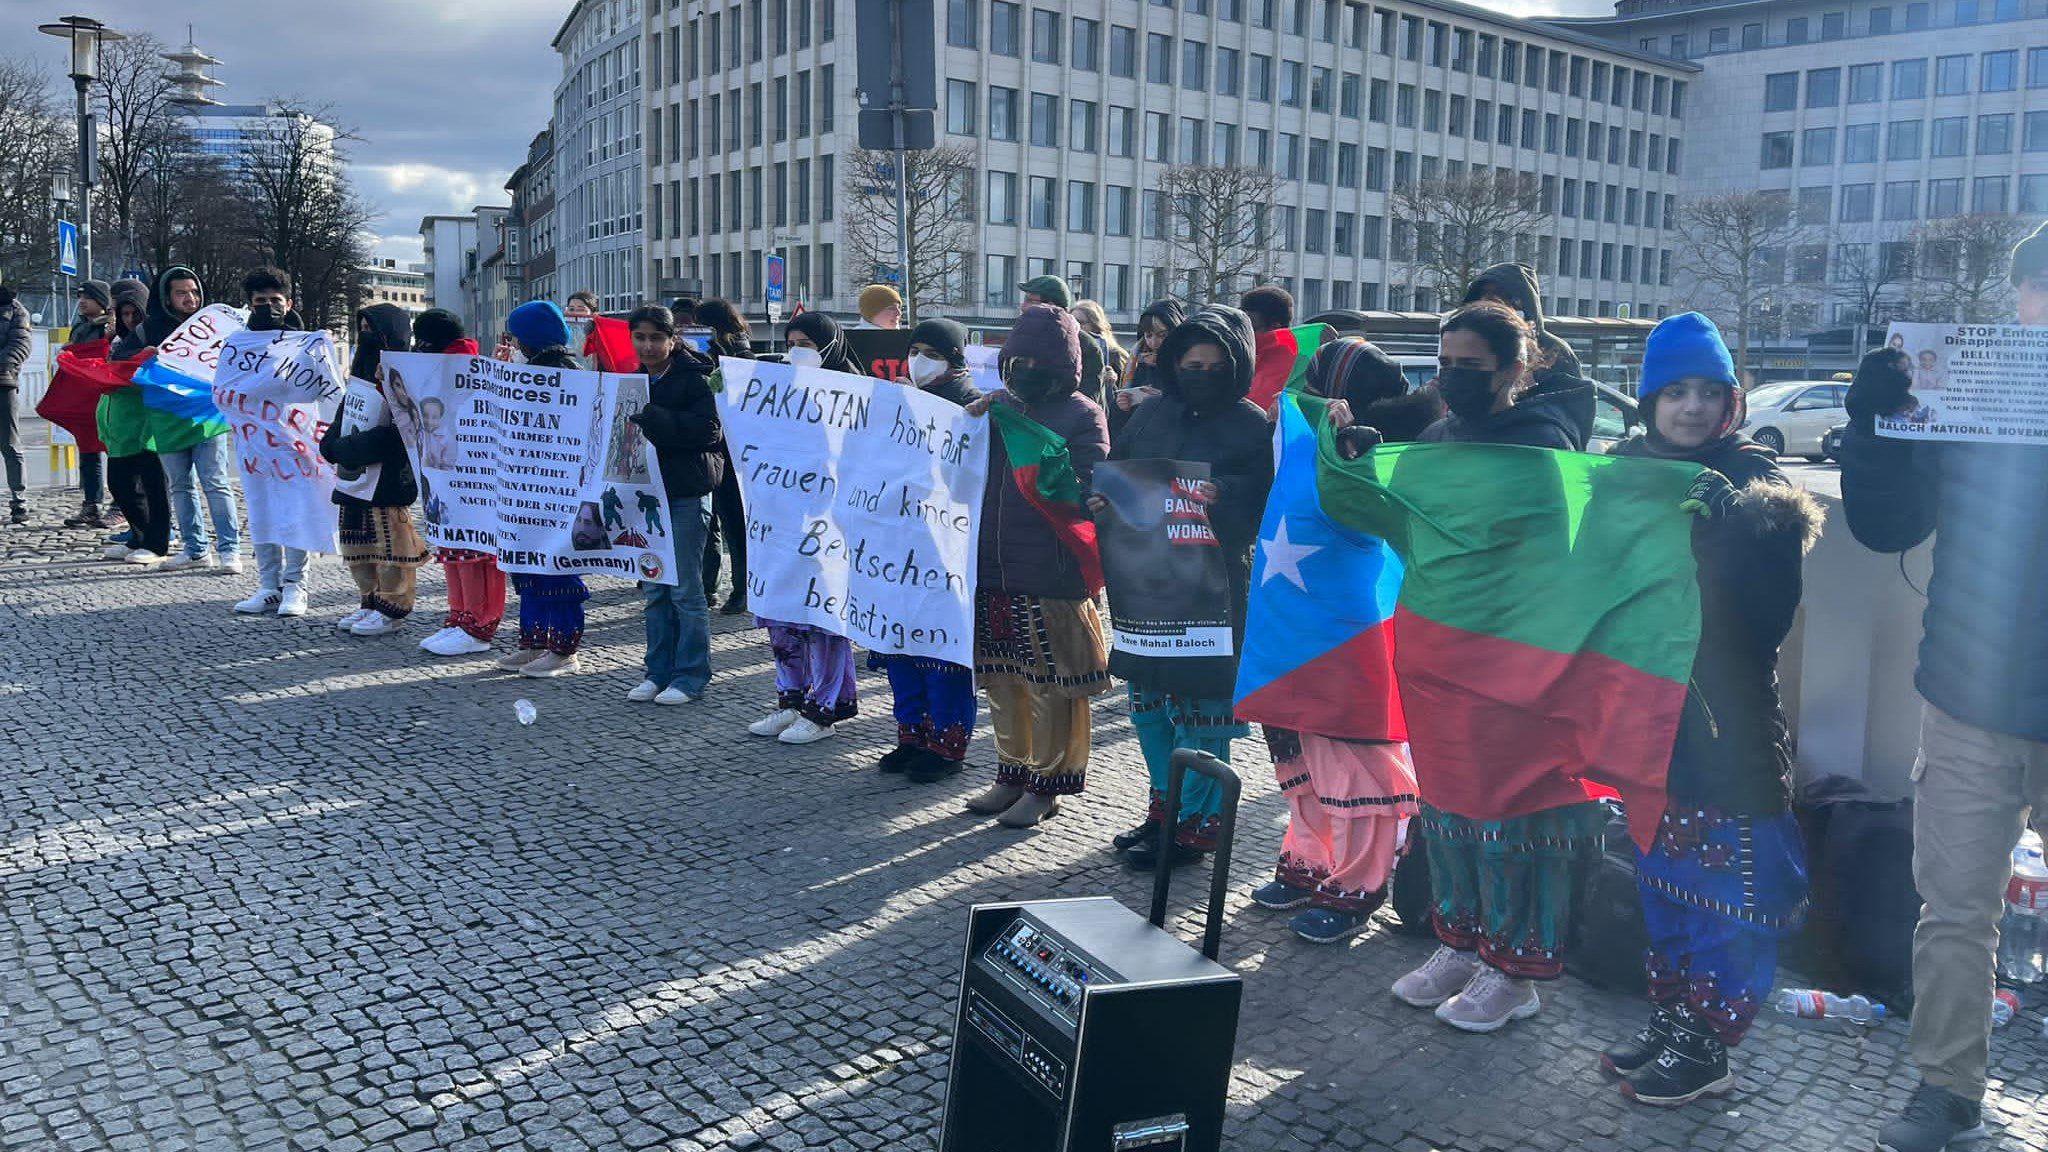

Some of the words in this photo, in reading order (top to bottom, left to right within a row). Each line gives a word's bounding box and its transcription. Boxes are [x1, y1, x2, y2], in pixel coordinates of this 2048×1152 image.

[769, 286, 782, 298] TAXI
[161, 314, 217, 358] STOP
[1958, 327, 1997, 337] STOP
[560, 389, 578, 406] in
[740, 378, 871, 432] PAKISTAN
[890, 405, 936, 454] hört
[940, 430, 971, 466] auf
[459, 418, 478, 427] DIE
[509, 431, 553, 444] ARMEE
[557, 436, 581, 446] UND
[1930, 424, 1993, 436] NATIONAL
[467, 450, 488, 460] VON
[455, 465, 476, 474] WIR
[741, 444, 838, 495] Frauen
[848, 480, 886, 513] und
[460, 496, 487, 507] NACH
[516, 499, 540, 510] DER
[1167, 524, 1215, 540] WOMEN
[553, 551, 636, 574] (Germany)
[804, 577, 959, 648] belästigen.
[1140, 638, 1171, 648] Mahal
[1175, 638, 1215, 648] Baloch
